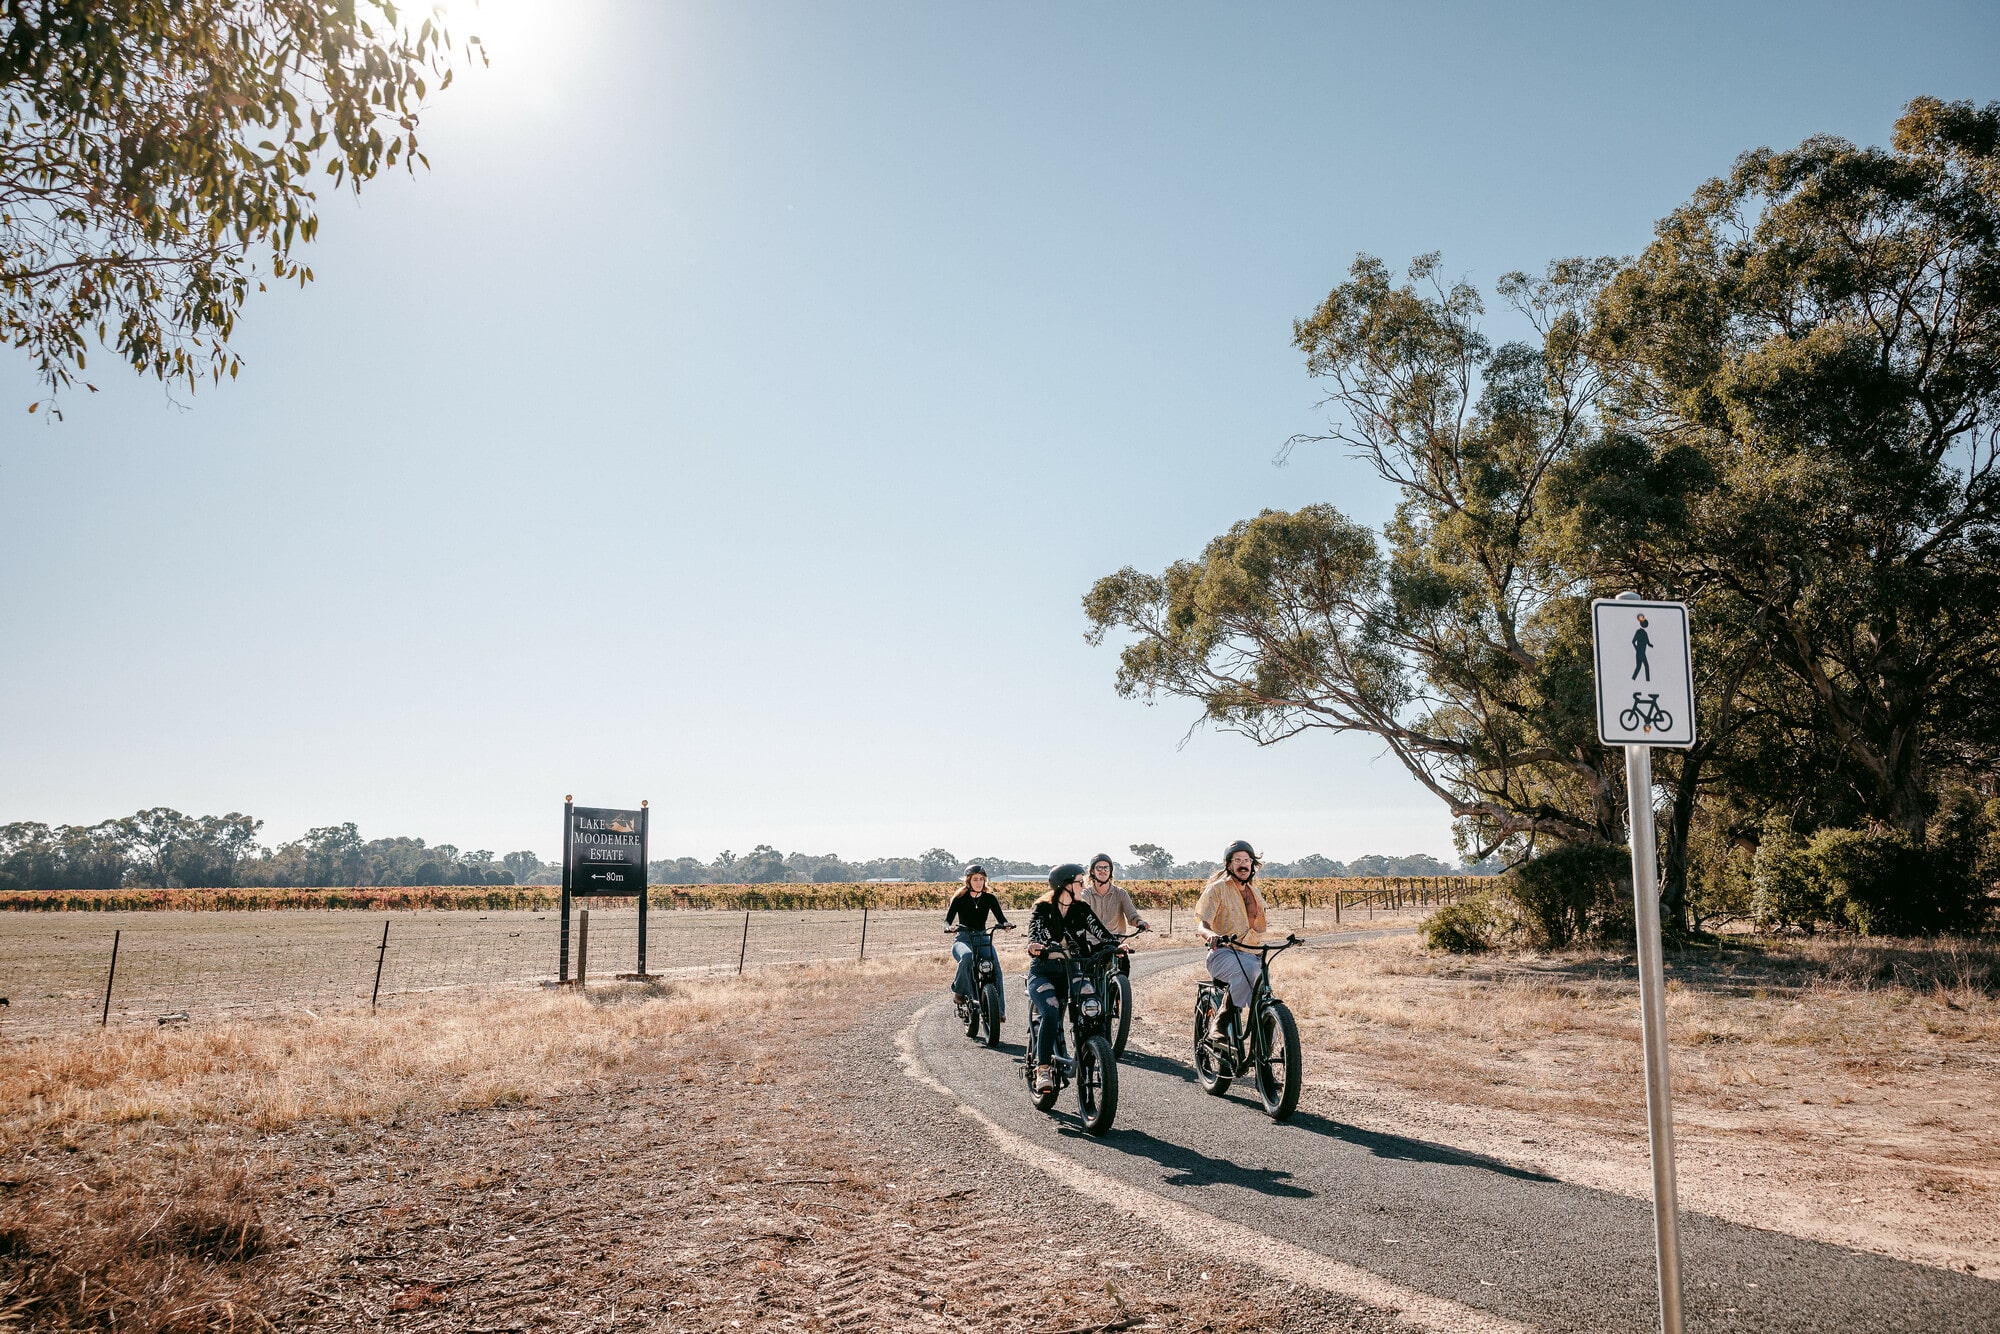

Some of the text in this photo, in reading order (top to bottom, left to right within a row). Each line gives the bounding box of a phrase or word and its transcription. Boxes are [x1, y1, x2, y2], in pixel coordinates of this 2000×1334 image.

[579, 818, 605, 830] LAKE
[574, 831, 640, 846] MOODEMERE
[590, 848, 624, 861] ESTATE
[606, 872, 624, 882] 80m
